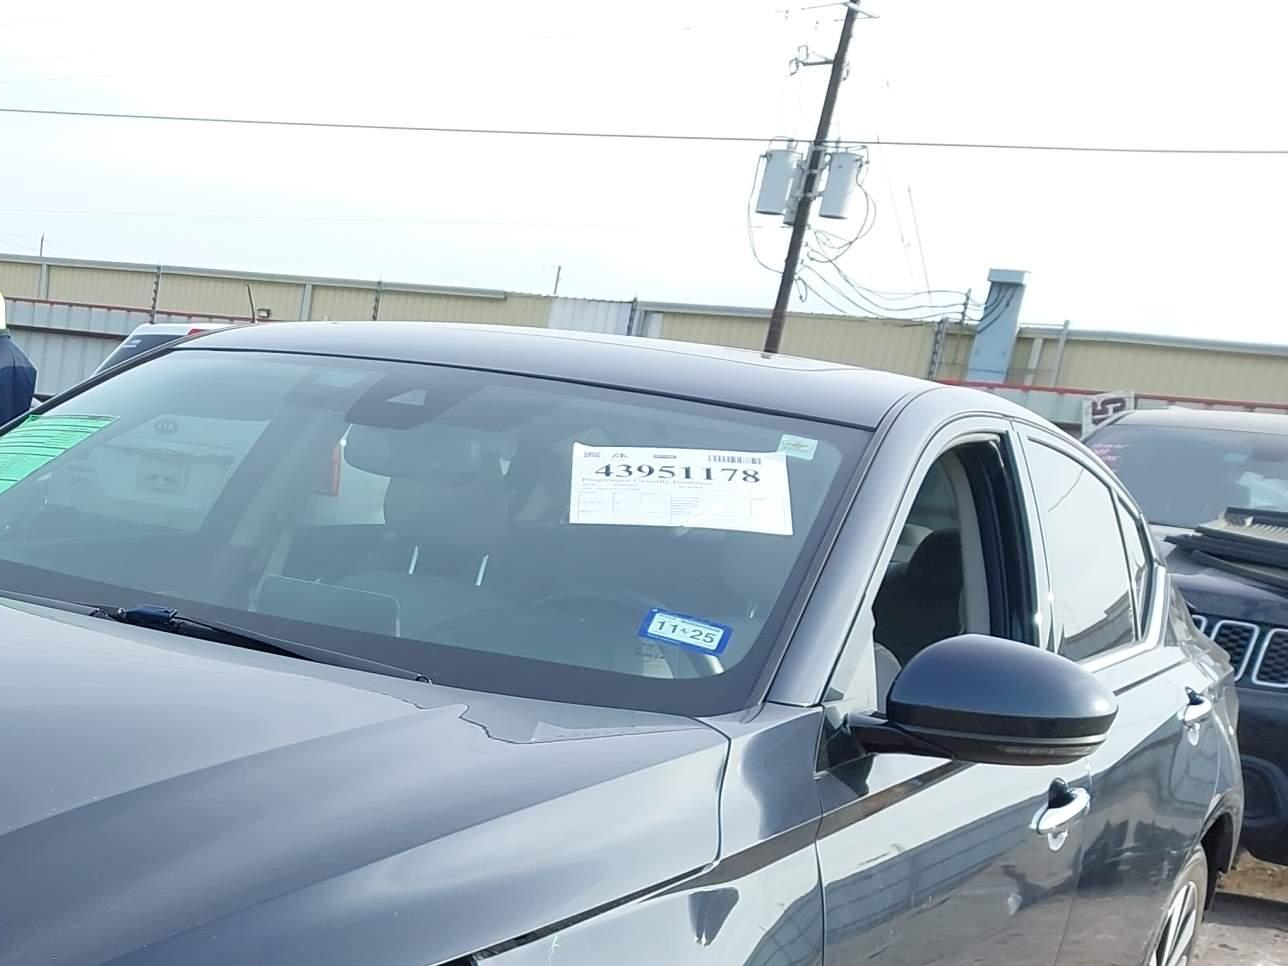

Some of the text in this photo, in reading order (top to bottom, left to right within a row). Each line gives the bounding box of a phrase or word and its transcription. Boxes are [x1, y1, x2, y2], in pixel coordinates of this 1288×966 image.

[594, 463, 761, 484] 43951178
[656, 620, 678, 634] 11
[689, 629, 717, 644] 25
